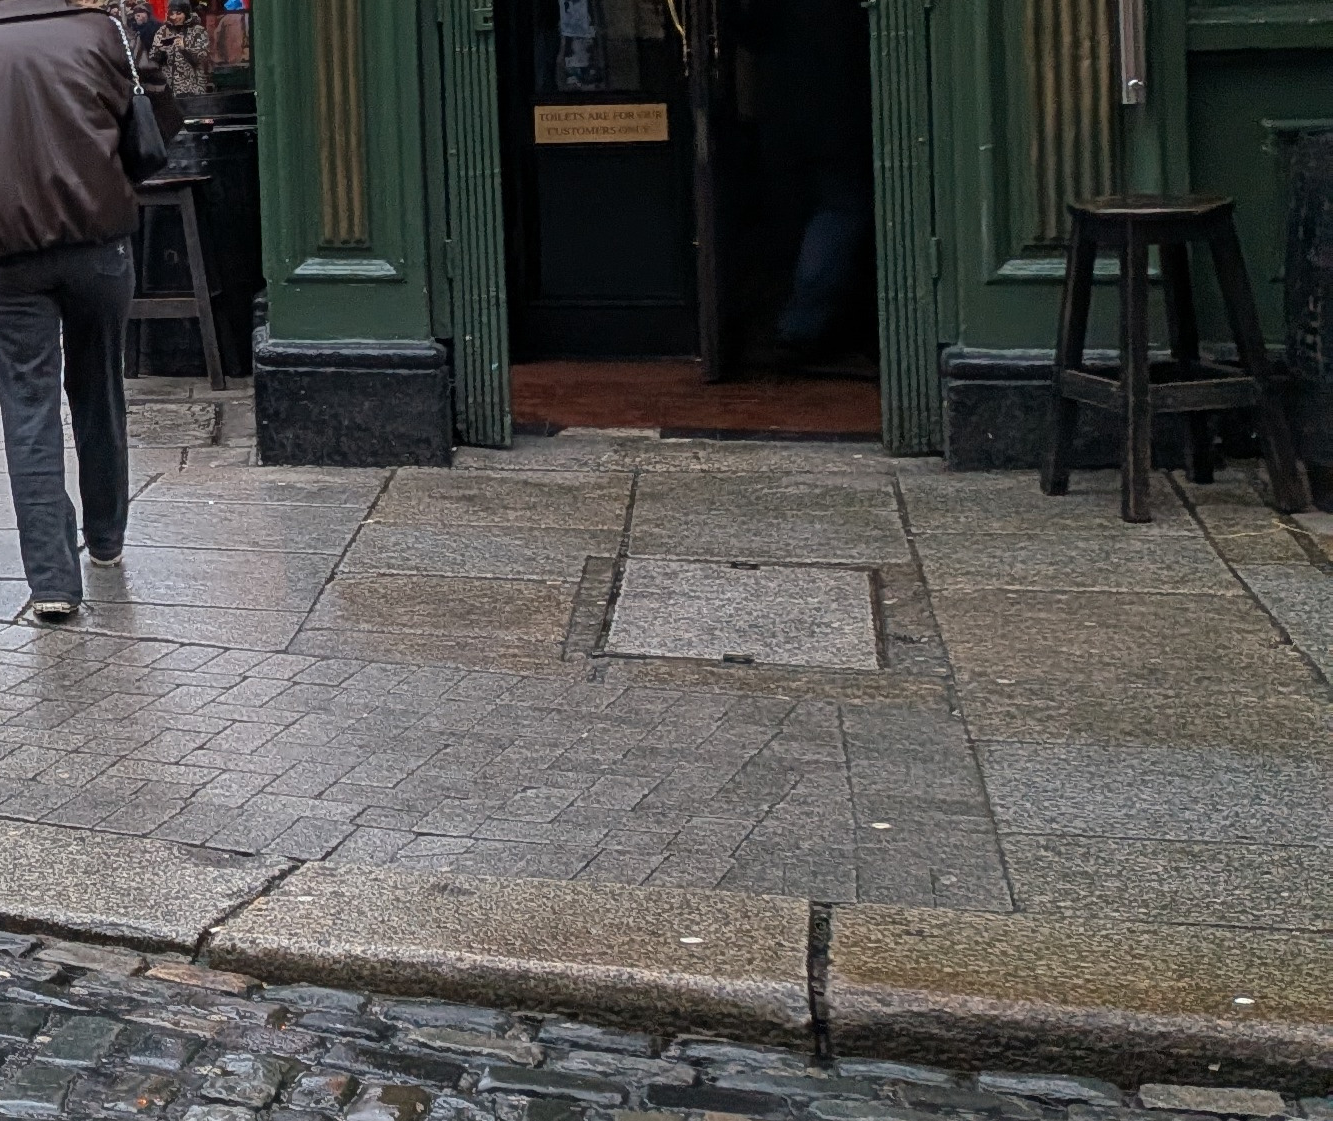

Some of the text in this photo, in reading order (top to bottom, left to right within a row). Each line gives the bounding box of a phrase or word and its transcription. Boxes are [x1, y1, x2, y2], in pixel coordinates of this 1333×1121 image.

[539, 112, 585, 122] TOILETS
[588, 111, 610, 121] ARE
[613, 111, 635, 120] FOR
[546, 125, 616, 136] CUSTOMERS
